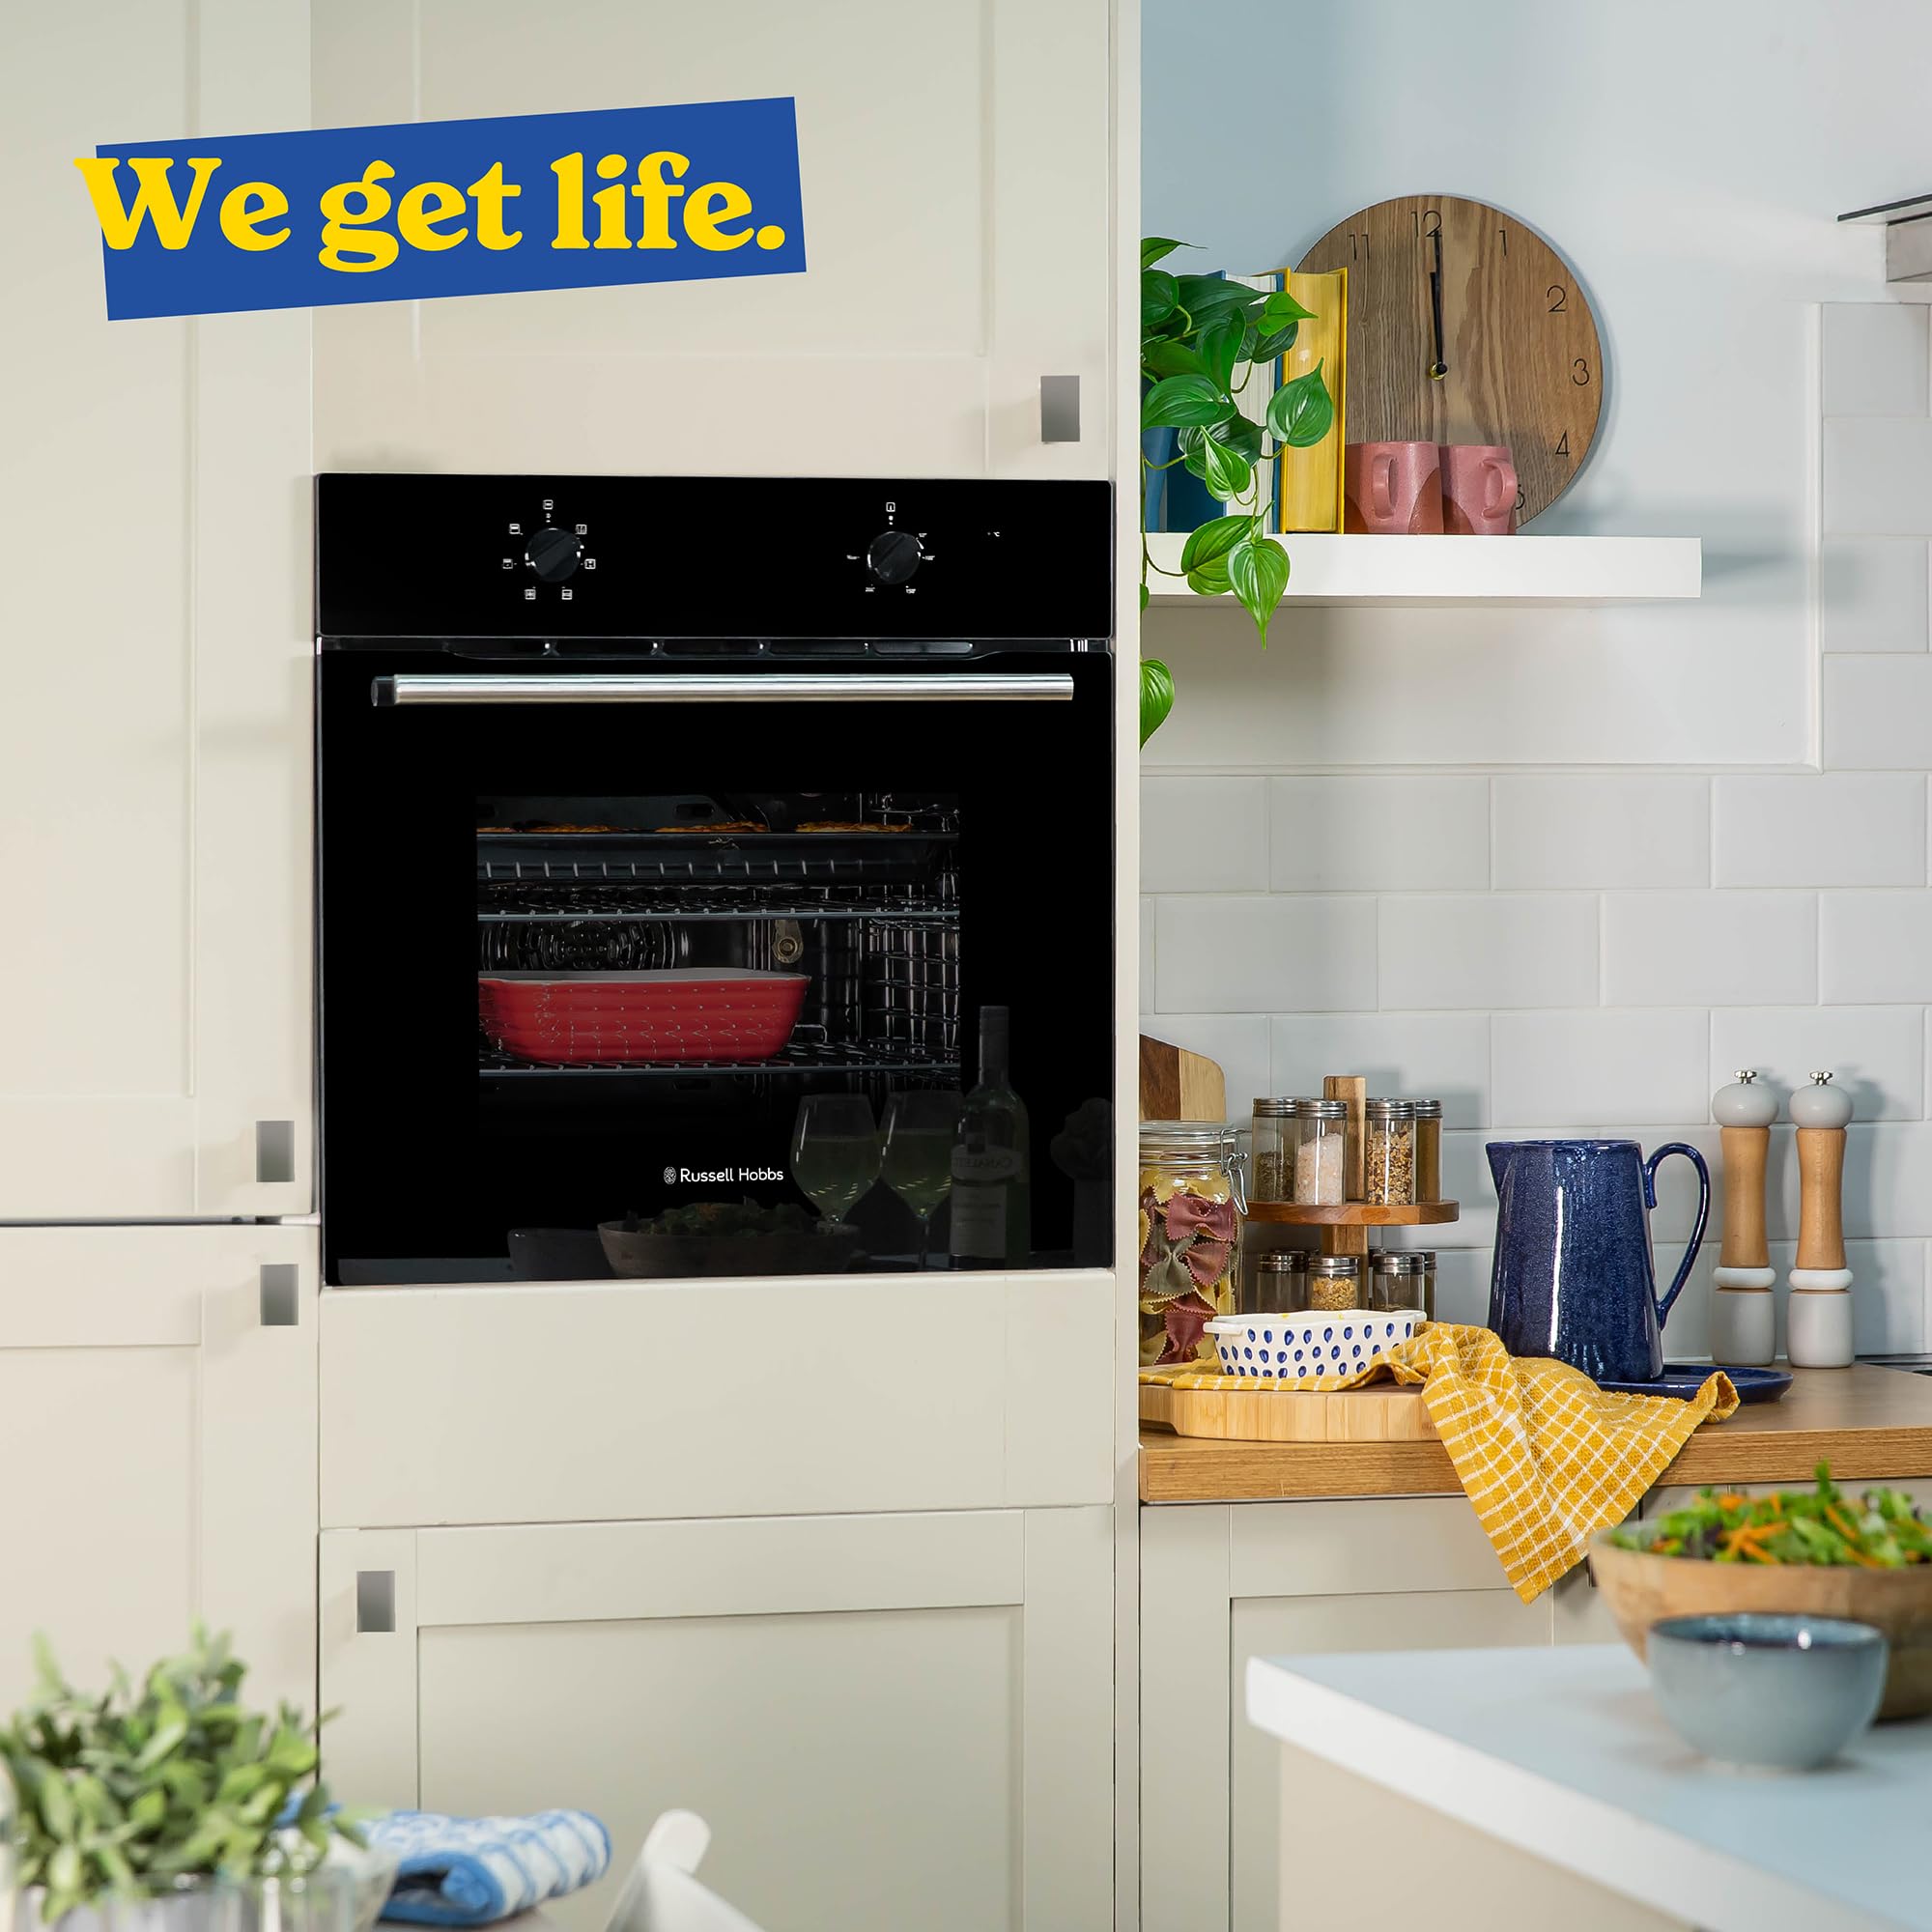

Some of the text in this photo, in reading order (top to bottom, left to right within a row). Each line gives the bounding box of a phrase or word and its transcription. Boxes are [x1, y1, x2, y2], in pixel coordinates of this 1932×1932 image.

[1410, 210, 1442, 239] 12
[1349, 233, 1370, 261] 11
[1498, 229, 1508, 257] 1
[1547, 284, 1567, 313] 2
[1572, 357, 1590, 386] 3
[1554, 429, 1571, 458] 4
[679, 1166, 784, 1183] Russell Hobbs
